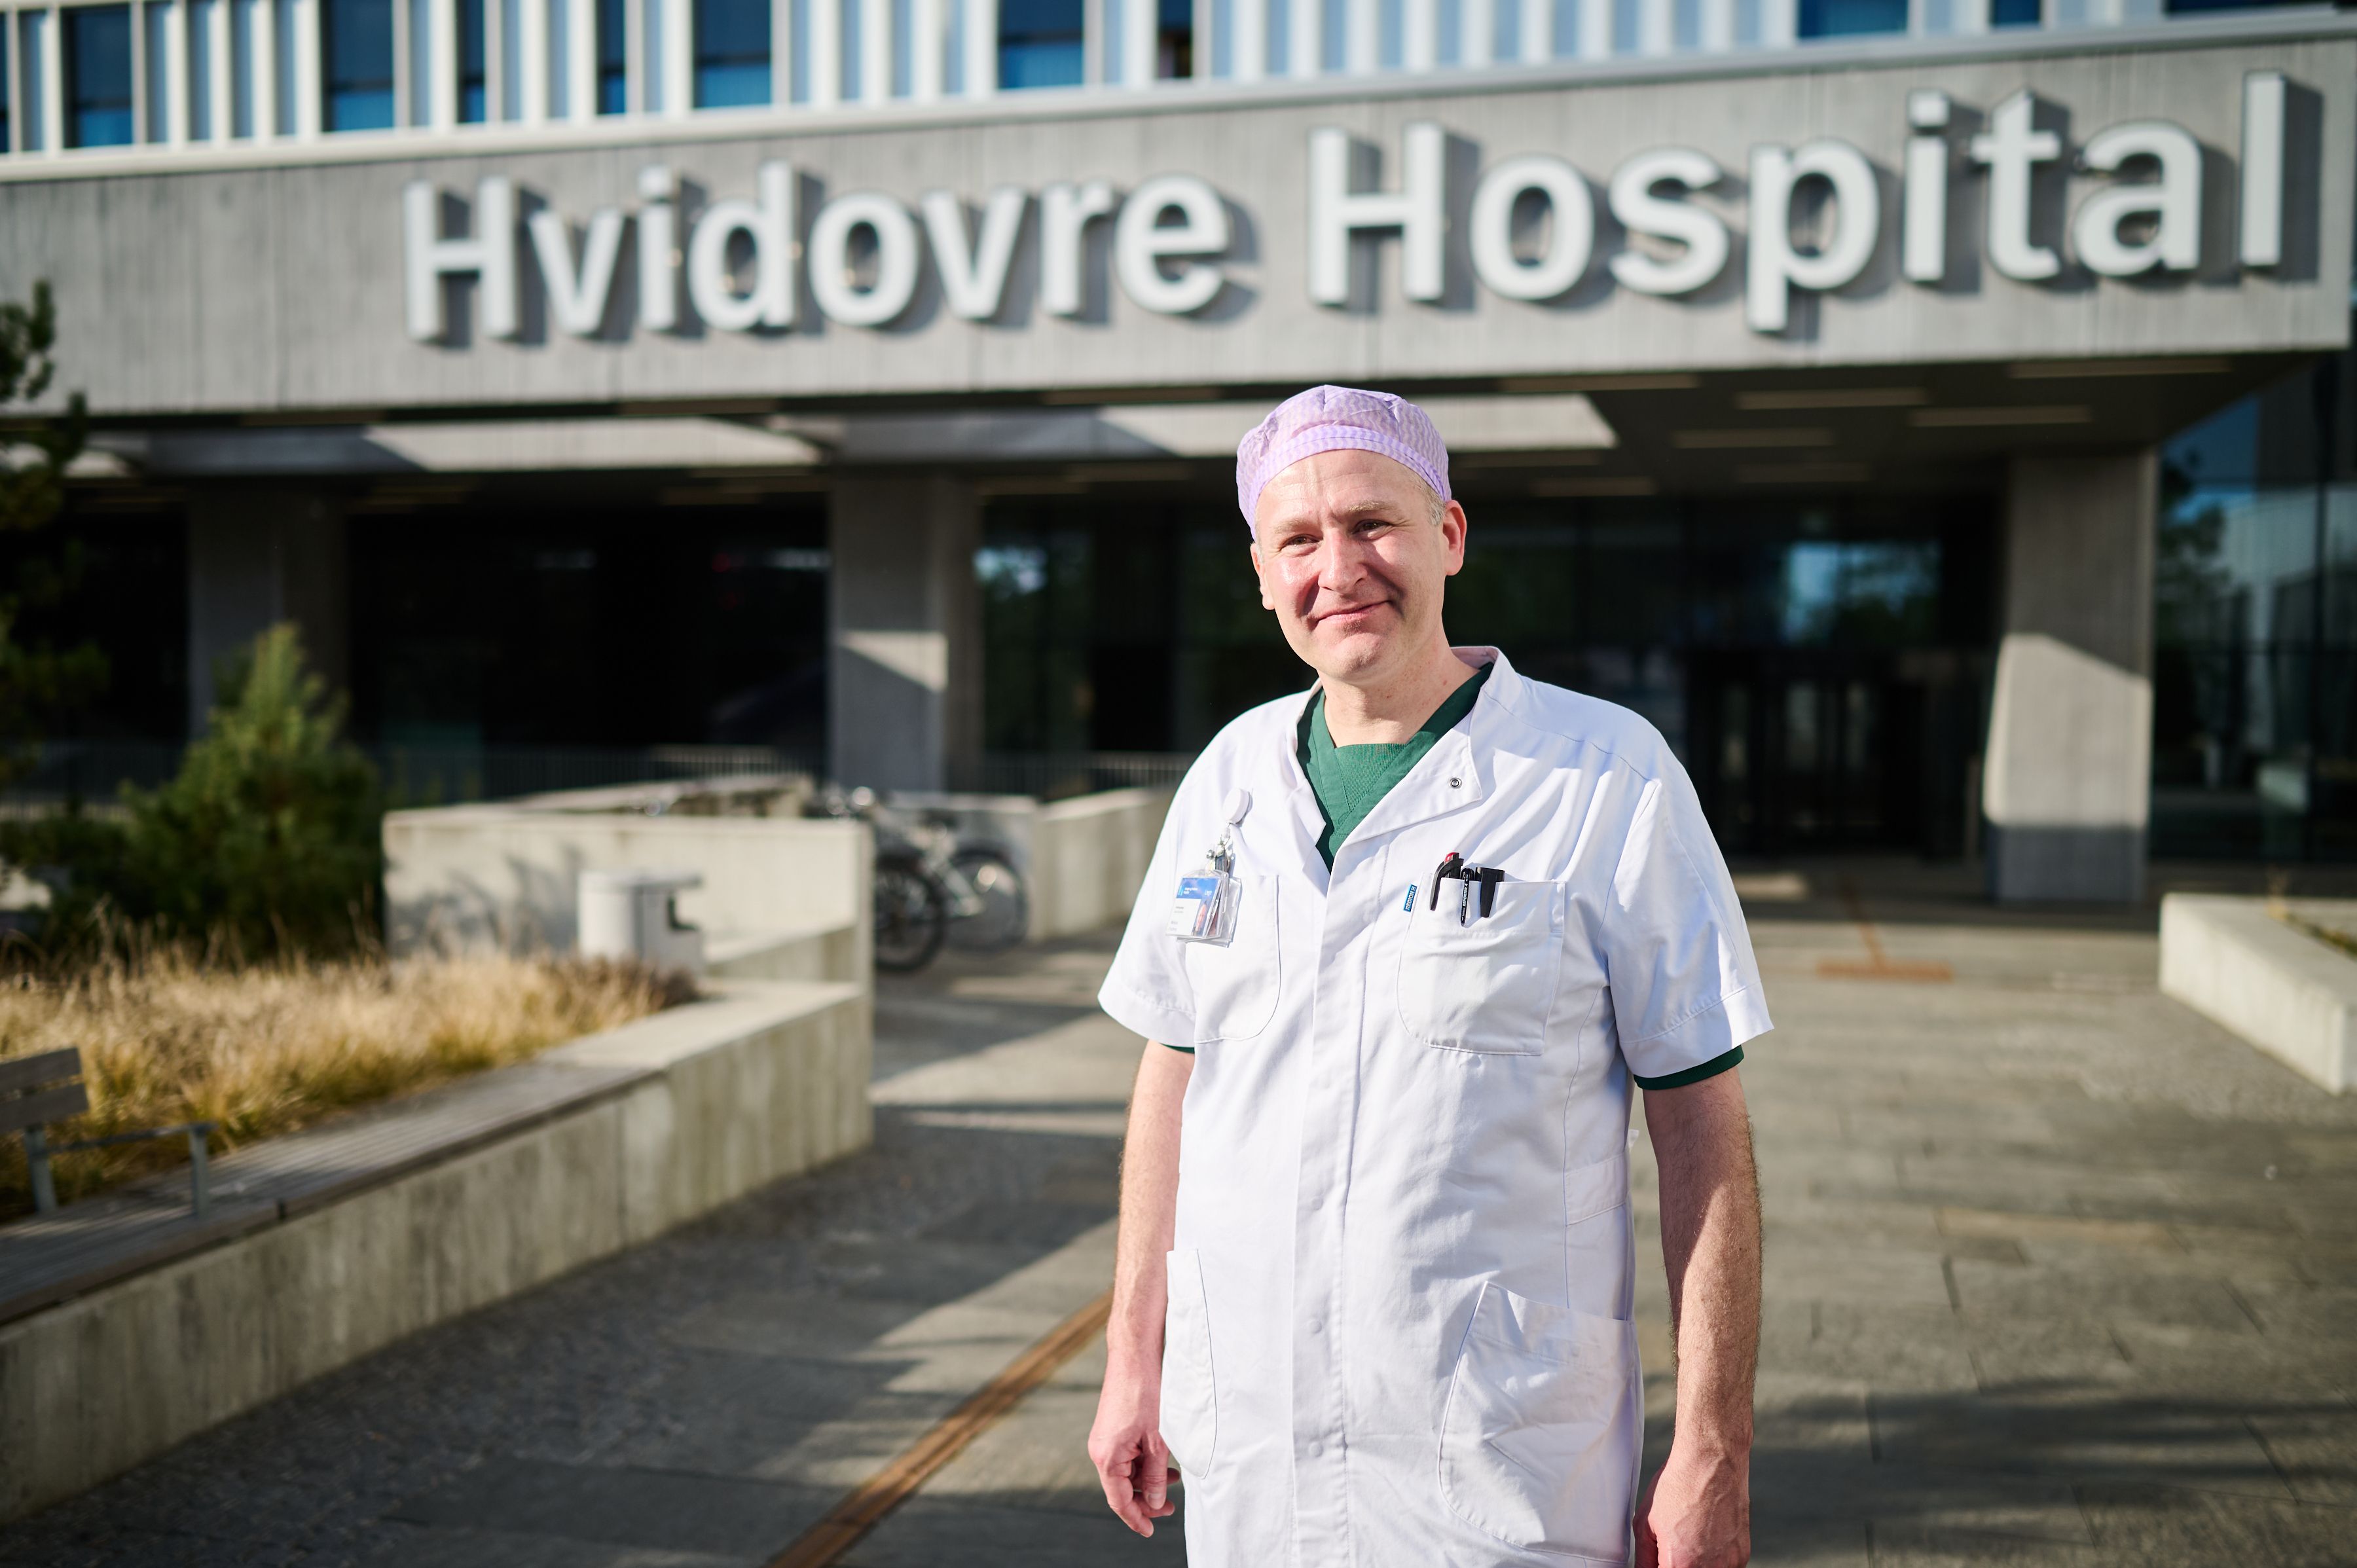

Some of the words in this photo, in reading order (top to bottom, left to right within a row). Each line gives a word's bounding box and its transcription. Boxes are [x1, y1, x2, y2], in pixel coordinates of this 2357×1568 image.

[403, 160, 1230, 342] Hvidovre
[1309, 71, 2286, 333] Hospital
[1405, 890, 1415, 909] REGION
